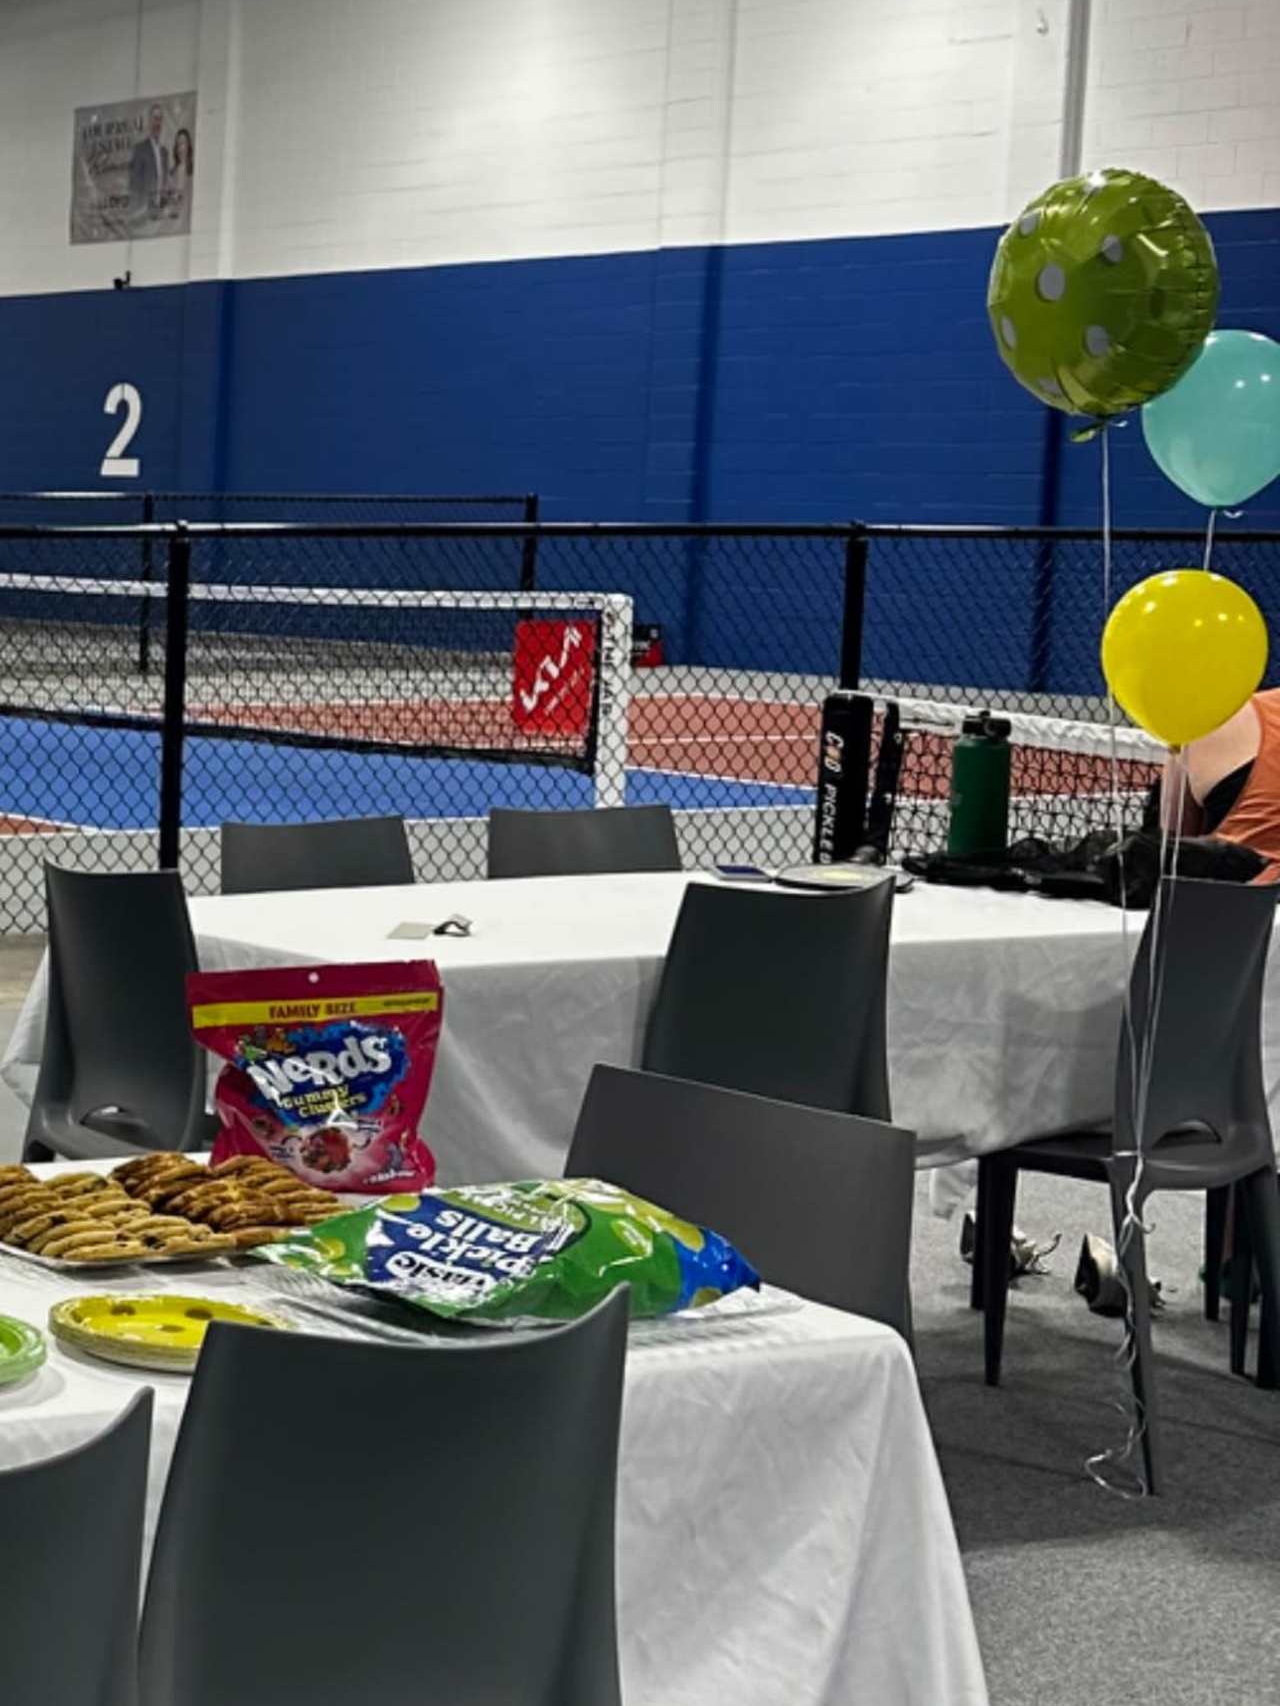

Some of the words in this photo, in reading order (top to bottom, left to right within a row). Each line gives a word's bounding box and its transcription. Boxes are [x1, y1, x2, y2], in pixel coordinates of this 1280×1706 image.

[100, 382, 142, 477] 2
[269, 1004, 320, 1019] FAMILY
[325, 1002, 357, 1015] SIZE
[405, 1222, 538, 1279] Pickle
[433, 1208, 541, 1253] Balls
